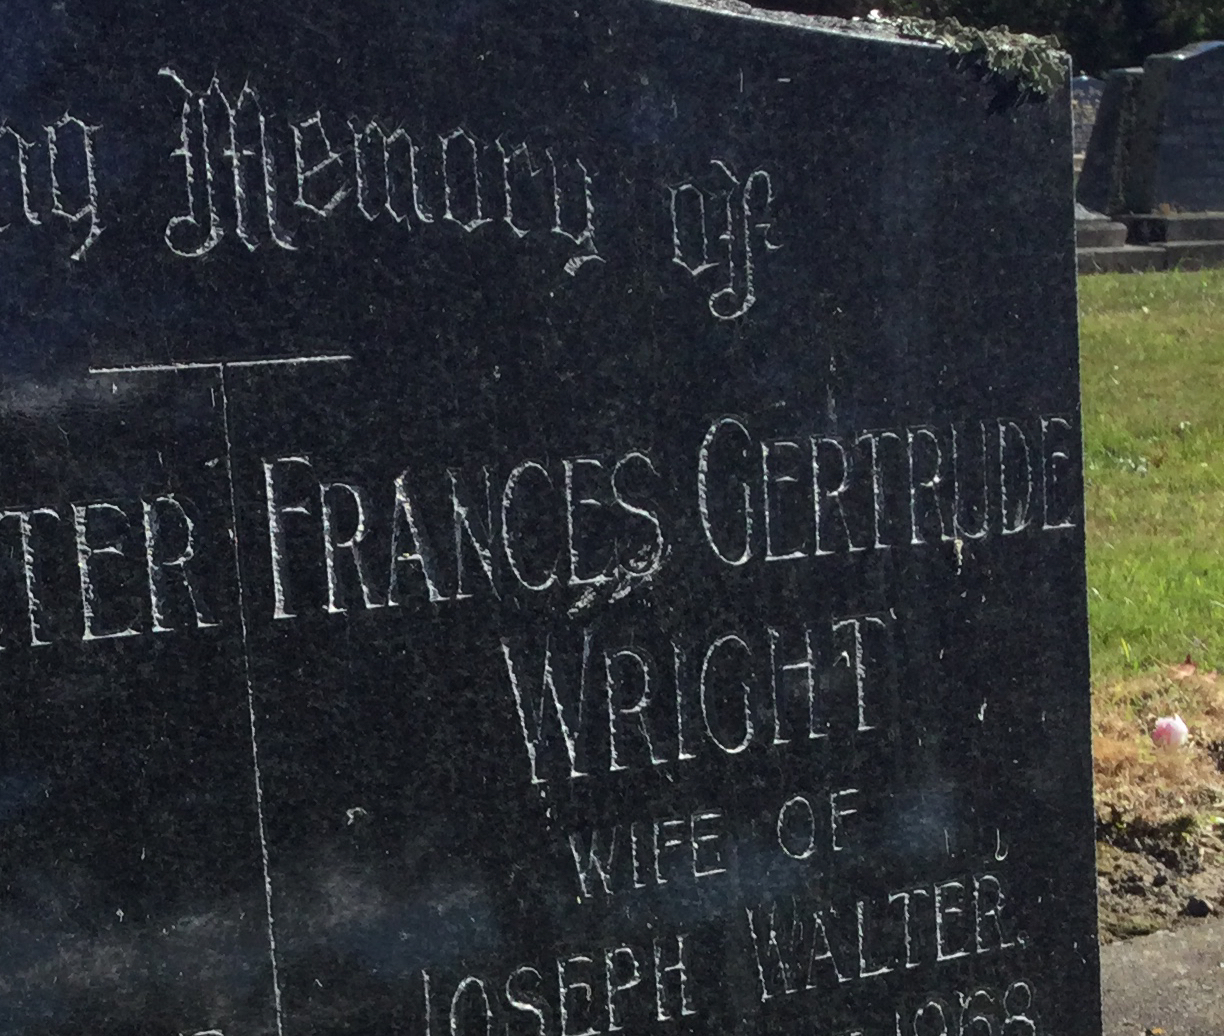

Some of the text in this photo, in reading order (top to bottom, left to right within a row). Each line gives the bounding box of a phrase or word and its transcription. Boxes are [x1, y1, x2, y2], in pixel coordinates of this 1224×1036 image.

[158, 65, 606, 276] Memory
[668, 159, 779, 320] of
[260, 416, 1078, 622] FRANCES GERTRUDE
[500, 614, 888, 786] WRIGHT
[568, 788, 860, 900] WIFE OF
